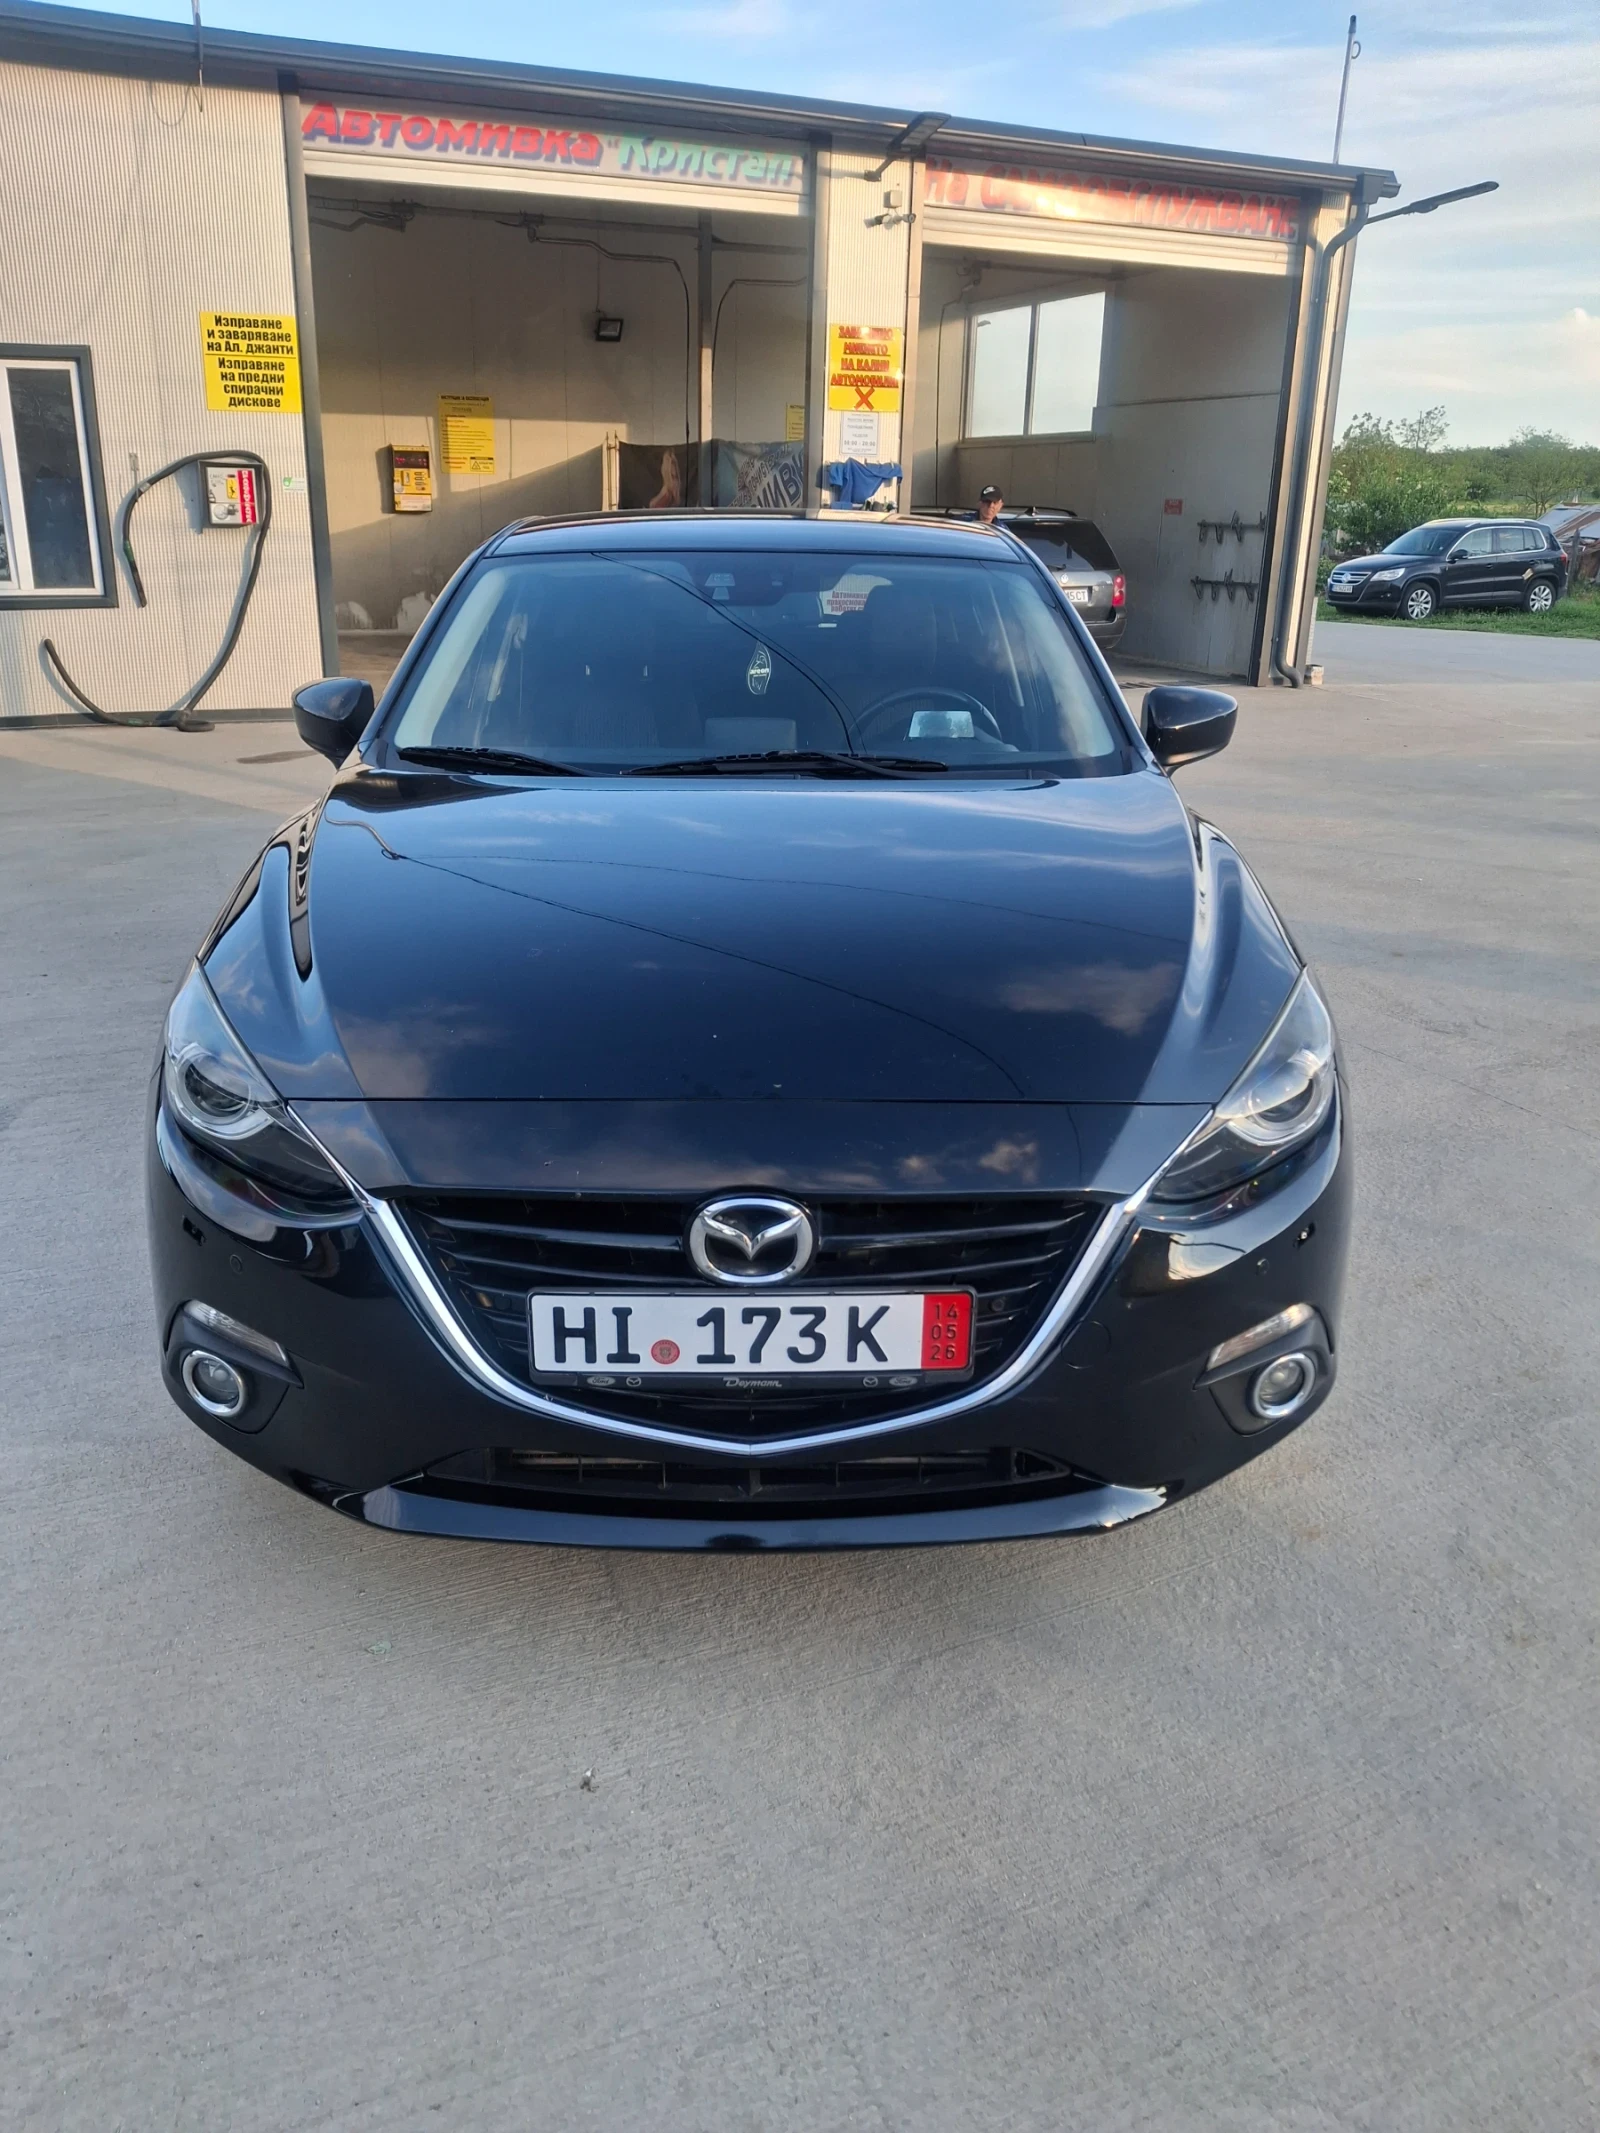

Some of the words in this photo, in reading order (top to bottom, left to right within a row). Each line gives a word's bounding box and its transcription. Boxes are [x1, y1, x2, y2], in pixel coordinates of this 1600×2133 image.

[301, 102, 602, 165] Автомивка
[925, 157, 969, 205] На
[214, 315, 282, 329] Изправяне
[207, 329, 215, 339] и
[218, 329, 291, 342] заваряване
[207, 342, 221, 351] на
[225, 341, 243, 352] Ал.
[246, 344, 294, 355] джанти
[218, 357, 285, 371] Изправяне
[841, 358, 854, 370] НА
[857, 359, 889, 371] КАЛНИ
[221, 371, 235, 381] на
[238, 372, 284, 384] предни
[224, 384, 283, 395] спирачни
[228, 397, 281, 407] дискове
[935, 1303, 957, 1319] 14
[552, 1306, 641, 1364] HI
[696, 1305, 827, 1364] 173
[846, 1305, 890, 1363] K
[931, 1324, 957, 1340] 05
[930, 1344, 956, 1360] 26
